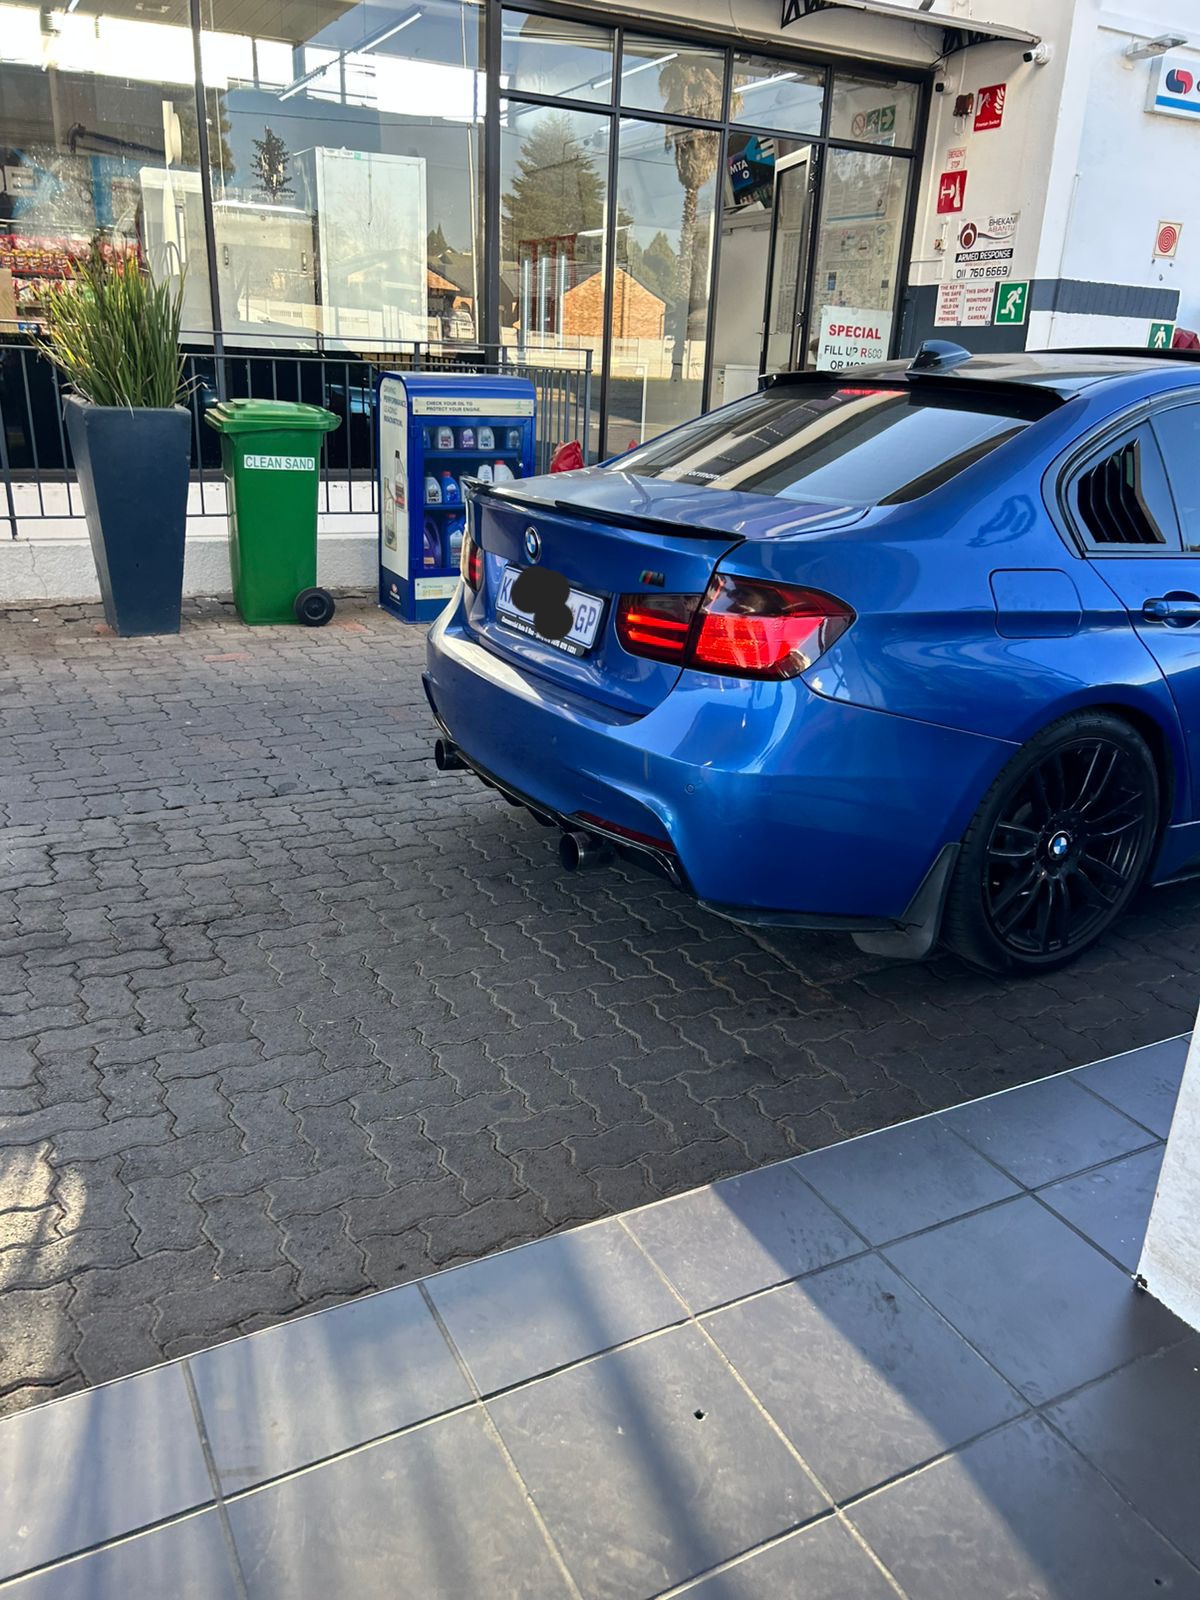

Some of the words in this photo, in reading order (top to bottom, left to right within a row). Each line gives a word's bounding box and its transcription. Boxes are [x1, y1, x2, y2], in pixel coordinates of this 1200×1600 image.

[958, 252, 979, 262] ARMED
[980, 249, 1012, 260] RESPONSE
[969, 267, 985, 277] 760
[828, 324, 881, 340] SPECIAL
[824, 345, 844, 356] FILL
[845, 345, 859, 357] UP
[830, 360, 844, 370] OR
[245, 456, 282, 469] CLEAN
[285, 457, 314, 470] SAND
[575, 604, 597, 634] GP
